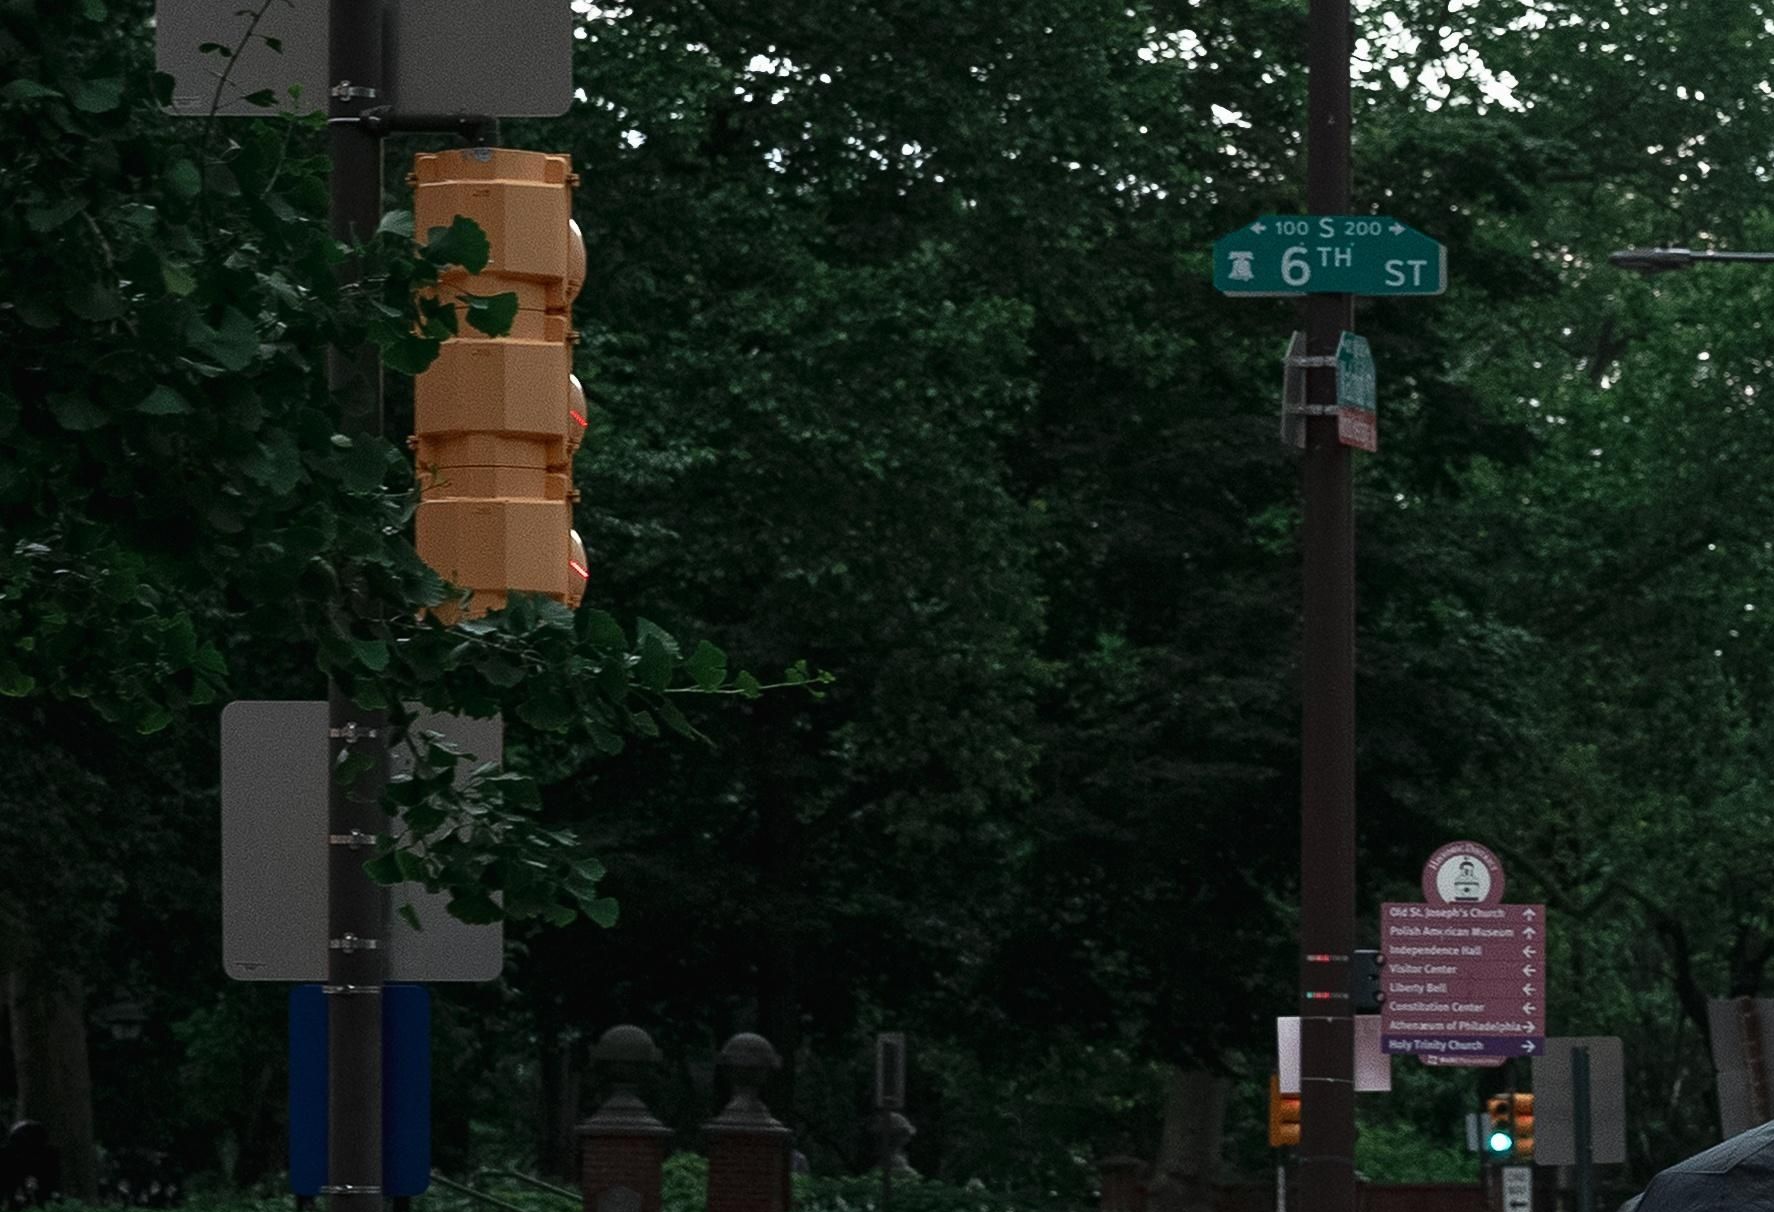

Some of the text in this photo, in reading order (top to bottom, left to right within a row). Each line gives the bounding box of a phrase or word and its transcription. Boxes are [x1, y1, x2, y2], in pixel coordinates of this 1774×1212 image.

[1275, 217, 1382, 238] 100 S 200
[1385, 260, 1428, 287] ST
[1389, 907, 1505, 920] Old St. Joseph's Church
[1389, 926, 1515, 937] Polish American Museum
[1389, 945, 1482, 956] Independence Hall
[1389, 964, 1457, 975] Visitor Center
[1389, 982, 1448, 994] Liberty Bell
[1389, 1001, 1485, 1012] Constitution Center
[1446, 1020, 1457, 1030] of
[1458, 1021, 1522, 1033] Philadelphia
[1388, 1040, 1484, 1052] Holy Trinity Church
